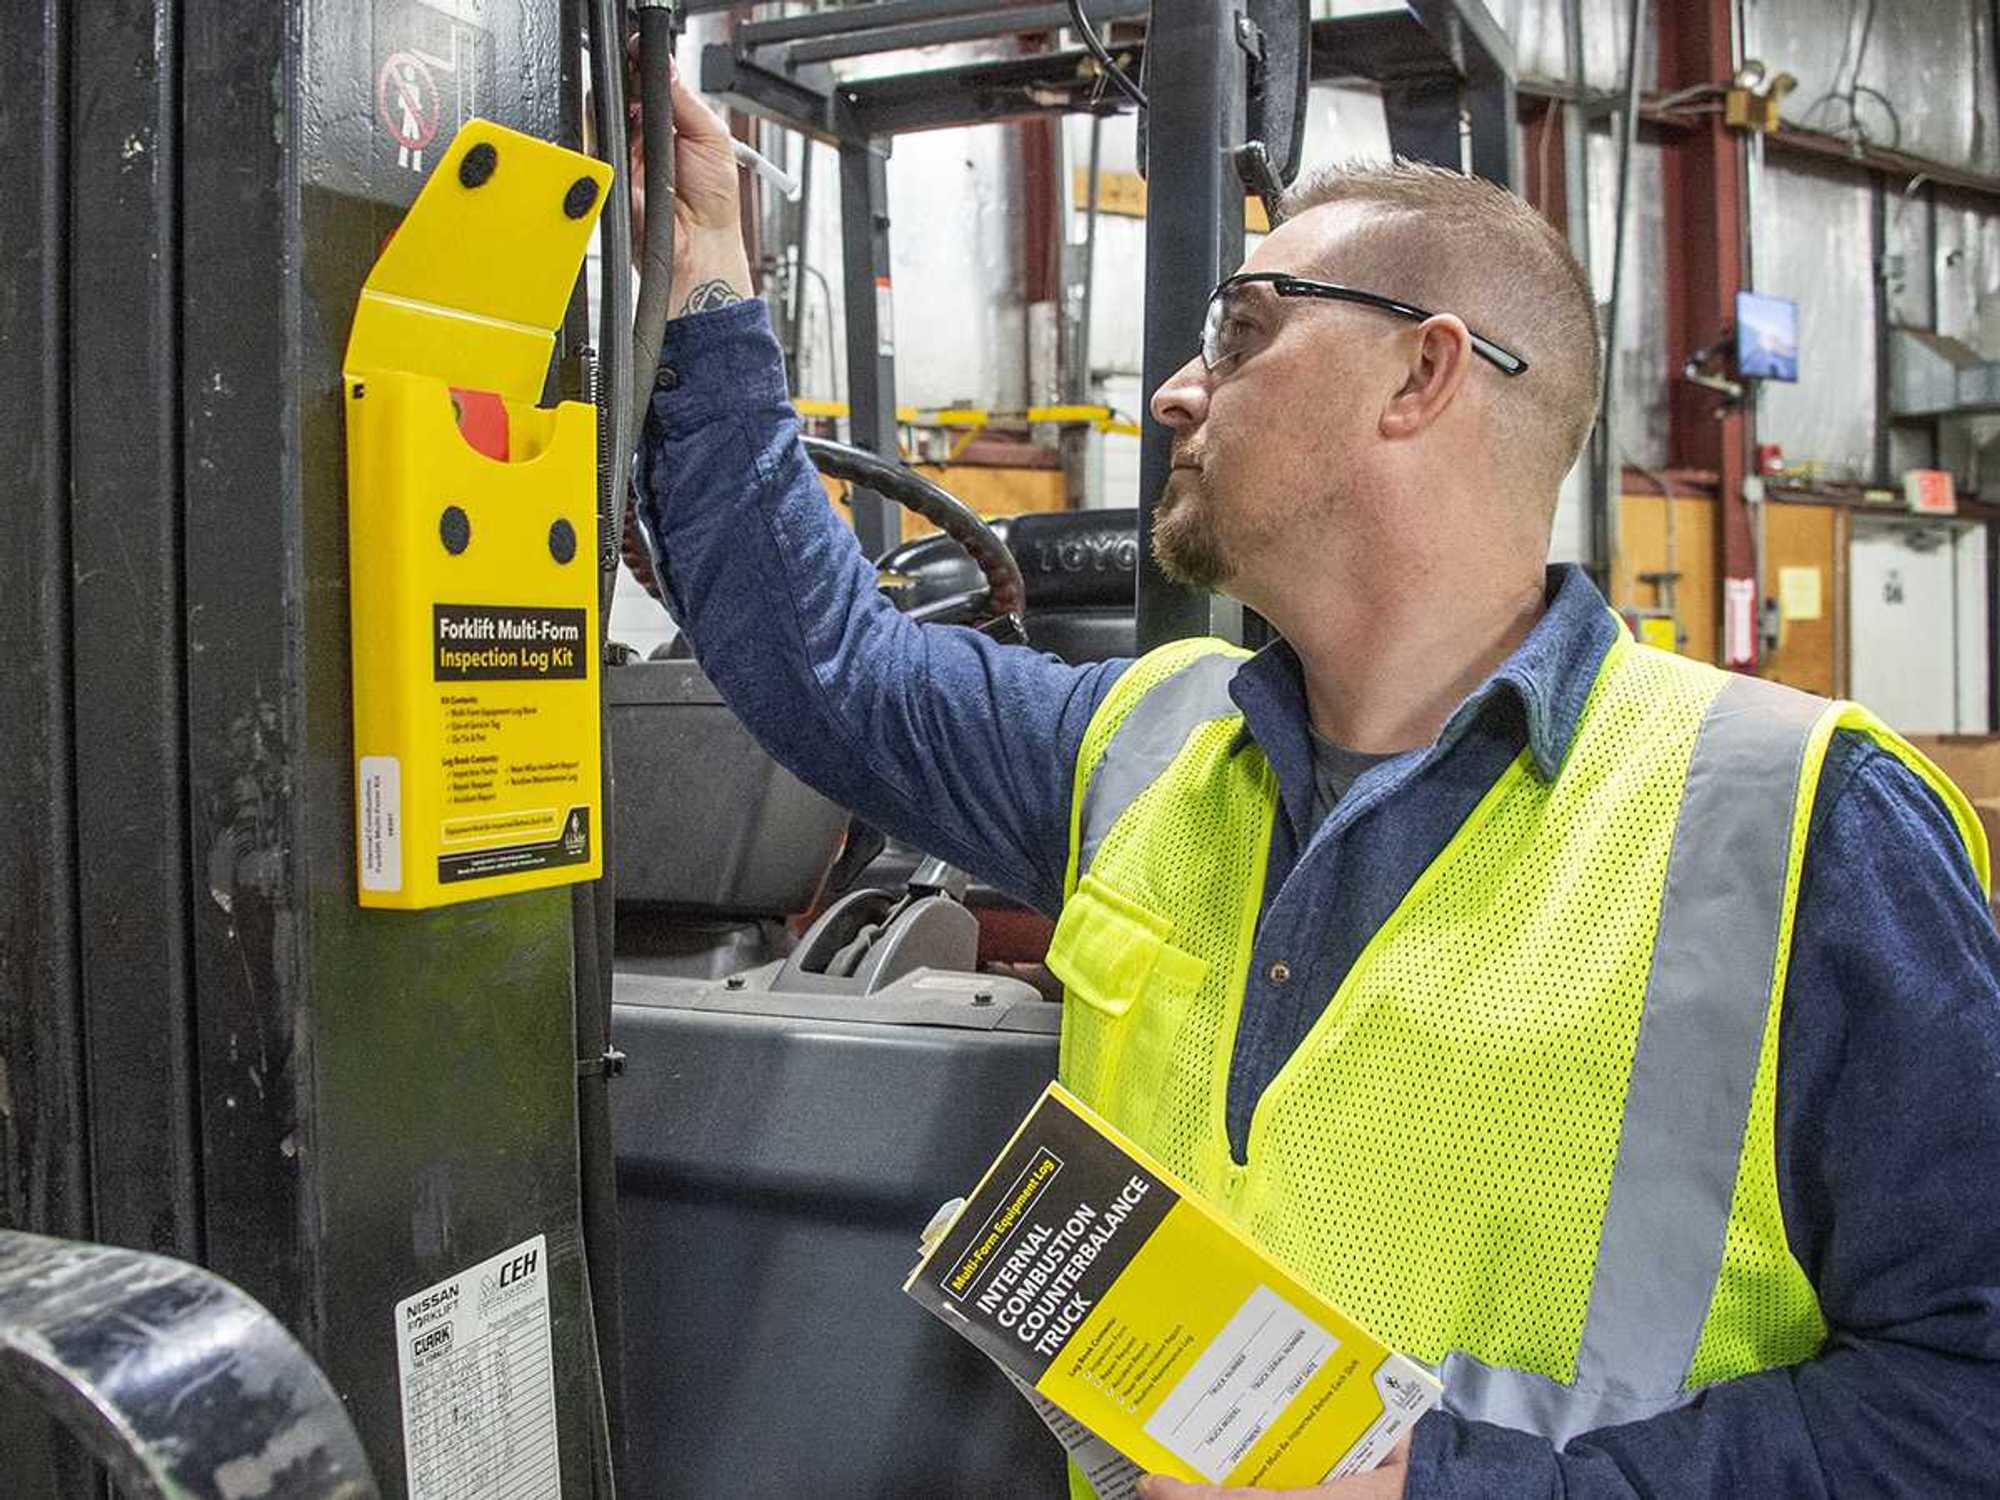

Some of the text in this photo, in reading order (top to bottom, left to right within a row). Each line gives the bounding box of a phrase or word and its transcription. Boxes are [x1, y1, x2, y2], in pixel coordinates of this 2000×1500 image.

[440, 617, 578, 640] Forklift Multi-Form
[440, 647, 573, 672] Inspection Log Kit
[952, 1158, 1055, 1290] Multi-Form Equipment Log
[500, 1250, 537, 1288] CEH
[976, 1220, 1053, 1315] INTERNAL
[996, 1203, 1097, 1330] COMBUSTION
[1015, 1175, 1149, 1344] COUNTERBALANCE
[407, 1284, 459, 1319] NISSAN
[1035, 1292, 1092, 1359] TRUCK
[414, 1326, 450, 1356] CLARK
